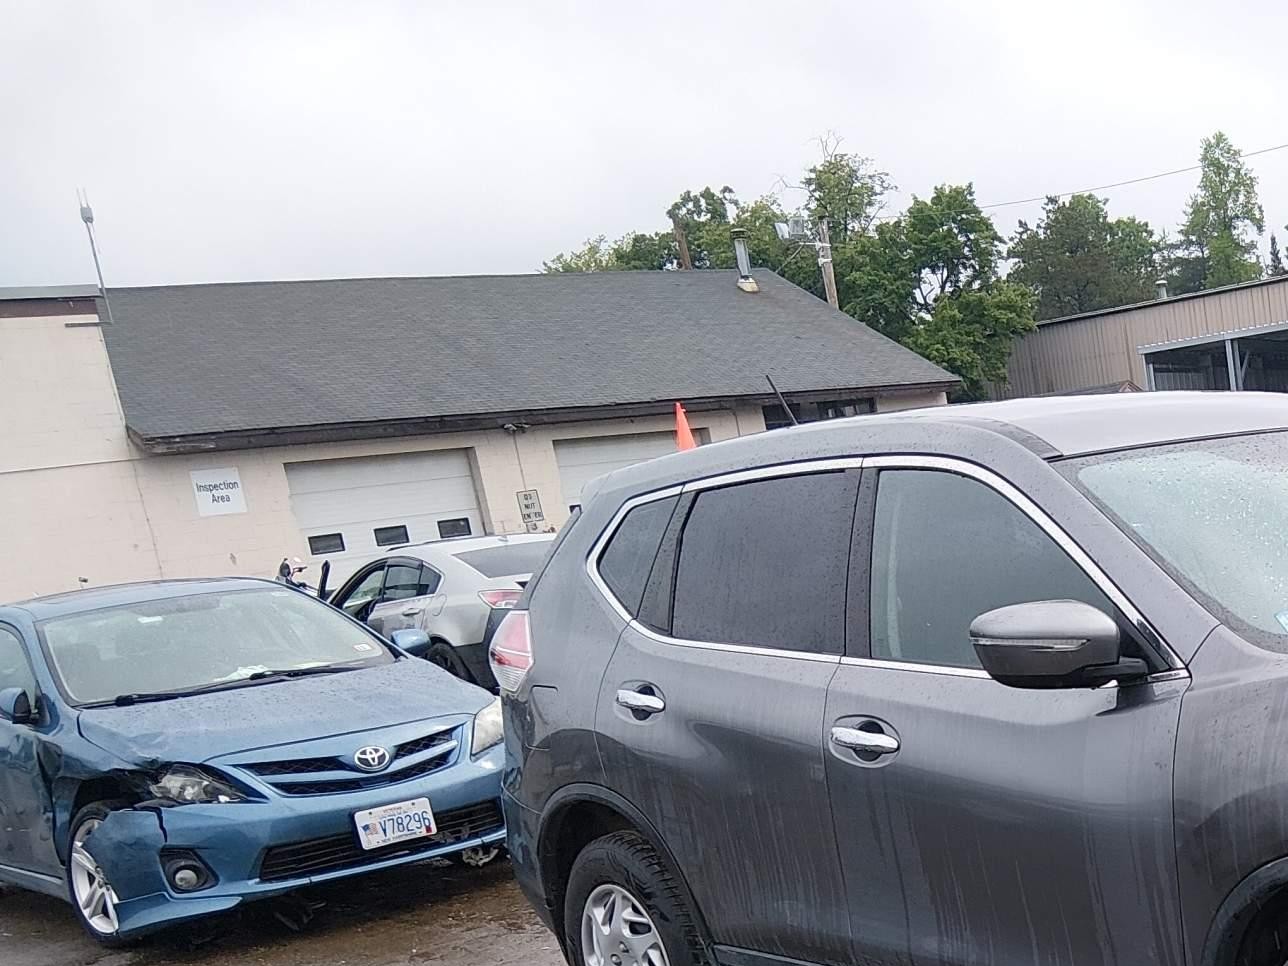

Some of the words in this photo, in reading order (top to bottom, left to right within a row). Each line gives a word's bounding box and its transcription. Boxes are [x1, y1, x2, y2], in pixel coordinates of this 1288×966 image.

[195, 481, 239, 493] Inspection
[211, 493, 231, 504] Area
[379, 810, 431, 838] V78296
